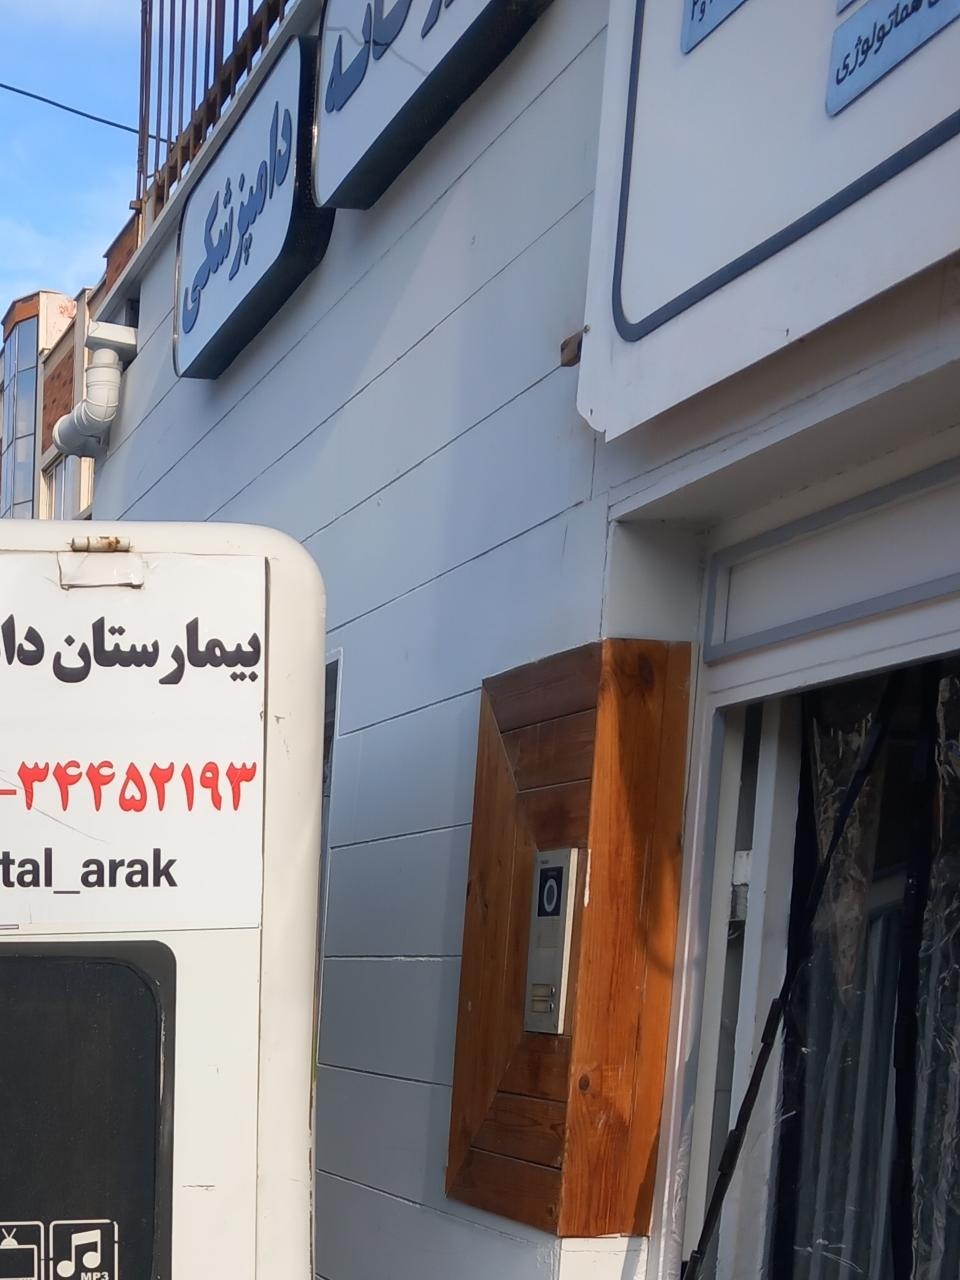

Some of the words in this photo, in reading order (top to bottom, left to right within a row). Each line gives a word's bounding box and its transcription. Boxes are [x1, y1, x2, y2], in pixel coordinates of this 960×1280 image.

[835, 0, 923, 85] هماتولوژی
[182, 100, 293, 334] دامپزشکی
[53, 616, 261, 684] بیمارستان
